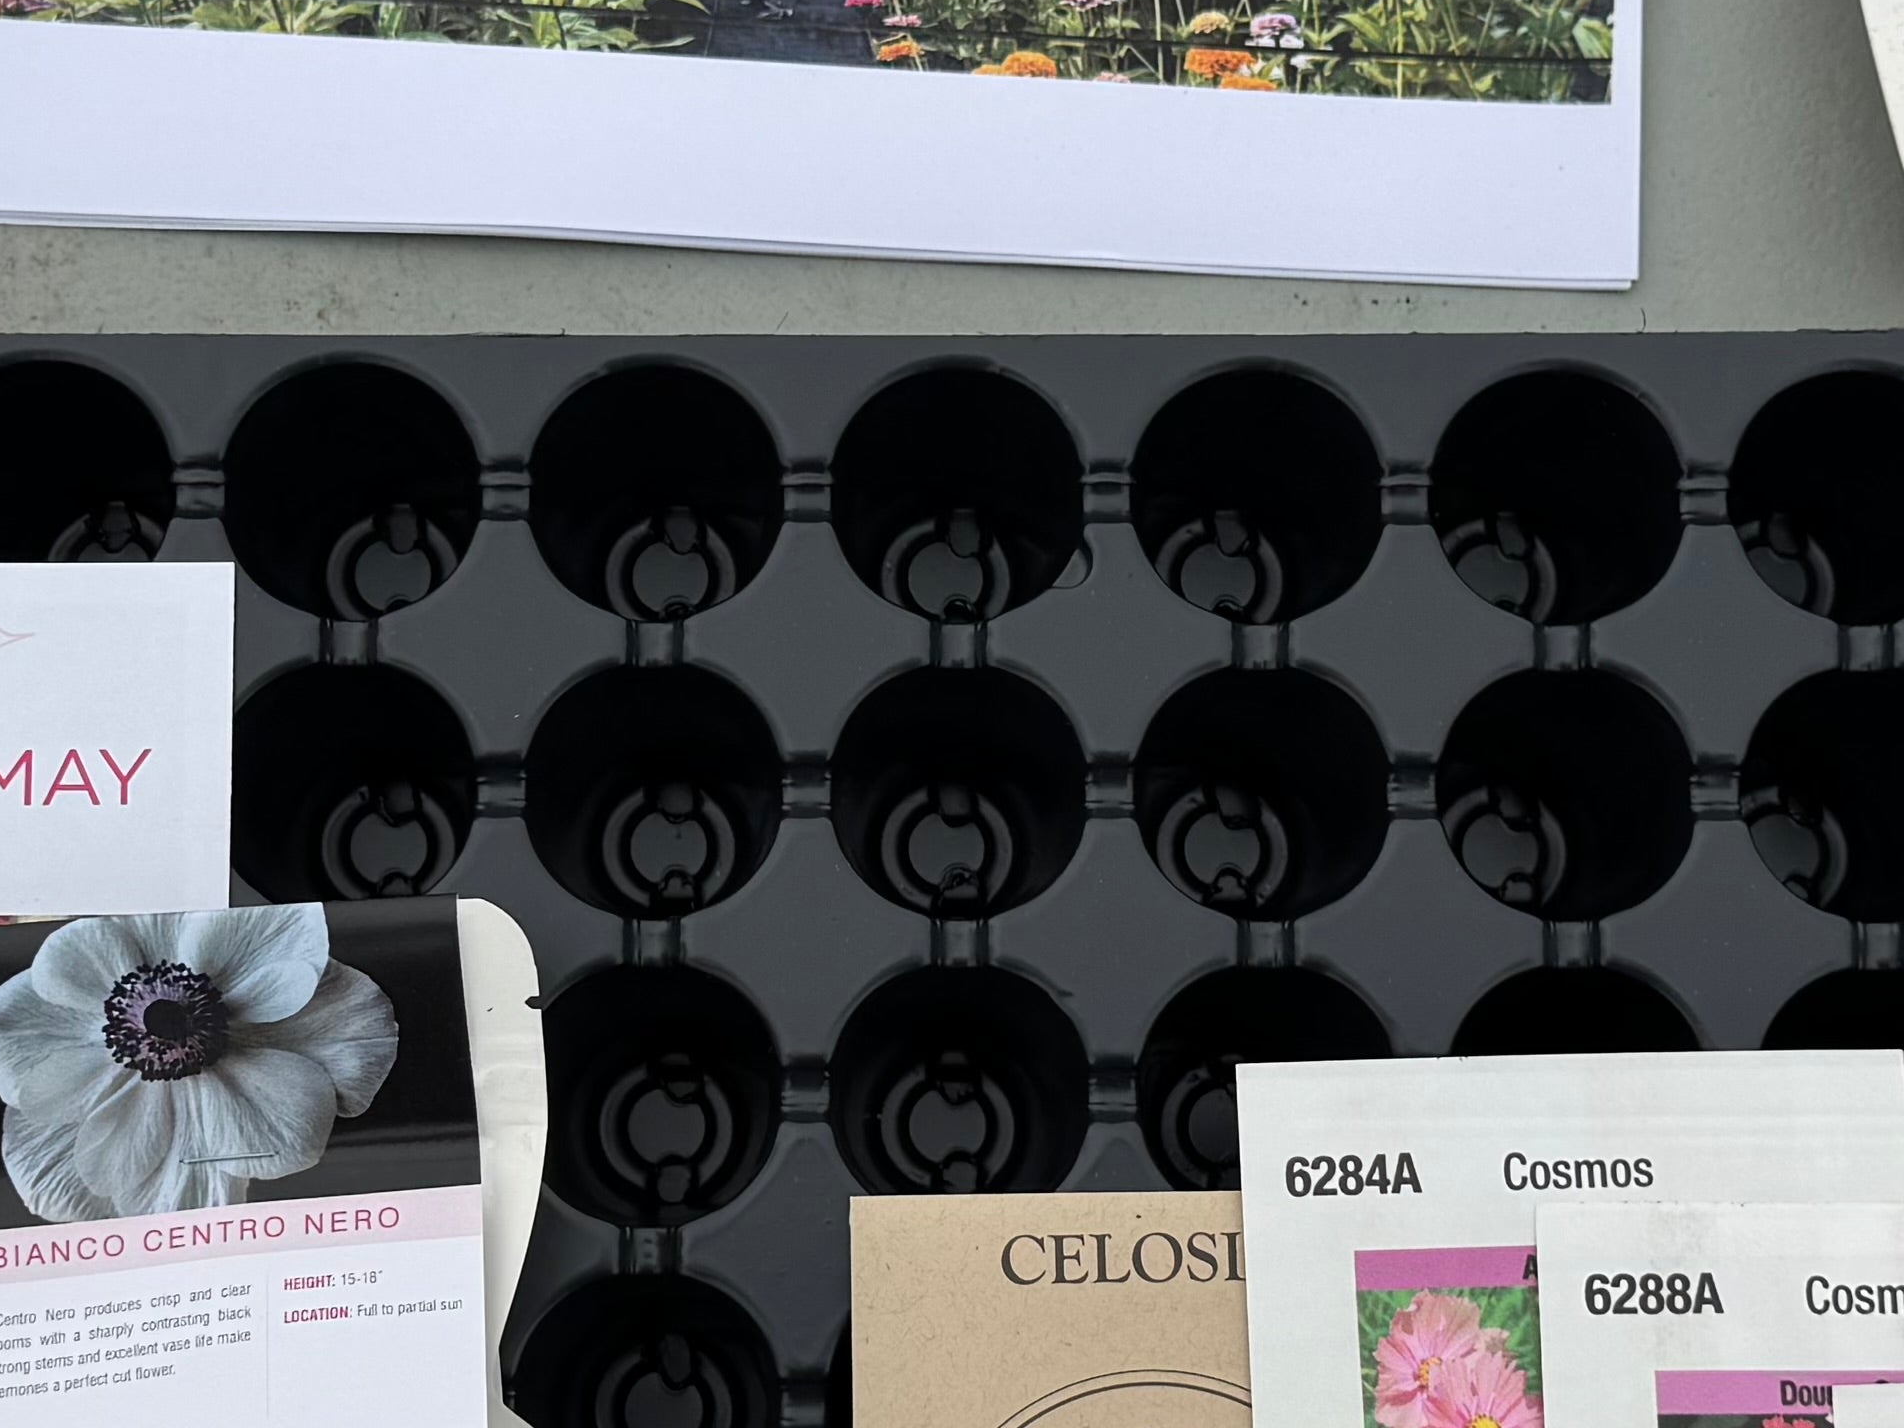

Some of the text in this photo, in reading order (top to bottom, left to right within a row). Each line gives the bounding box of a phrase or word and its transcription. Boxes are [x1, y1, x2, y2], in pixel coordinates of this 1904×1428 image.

[1284, 1150, 1655, 1198] 6284A Cosmos
[142, 1215, 286, 1252] CENTRO
[304, 1205, 401, 1236] NERO
[45, 1307, 76, 1322] Nero
[84, 1298, 142, 1320] produces
[150, 1292, 181, 1308] crisp
[189, 1287, 212, 1302] and
[220, 1283, 252, 1299] clear
[283, 1274, 336, 1291] HEIGHT:
[1584, 1271, 1725, 1316] 6288A
[39, 1331, 66, 1347] with
[73, 1330, 81, 1342] a
[88, 1321, 135, 1341] sharply
[140, 1312, 211, 1333] contrasting
[217, 1305, 252, 1322] black
[283, 1298, 463, 1324] LOCATION: Full to partial sun
[34, 1353, 74, 1371] stems
[77, 1349, 101, 1365] and
[104, 1341, 159, 1362] excellent
[161, 1337, 192, 1353] vase
[195, 1332, 213, 1348] life
[216, 1328, 252, 1346] make
[52, 1380, 61, 1392] a
[64, 1373, 109, 1393] perfect
[112, 1368, 132, 1384] cut
[134, 1363, 177, 1381] flower.
